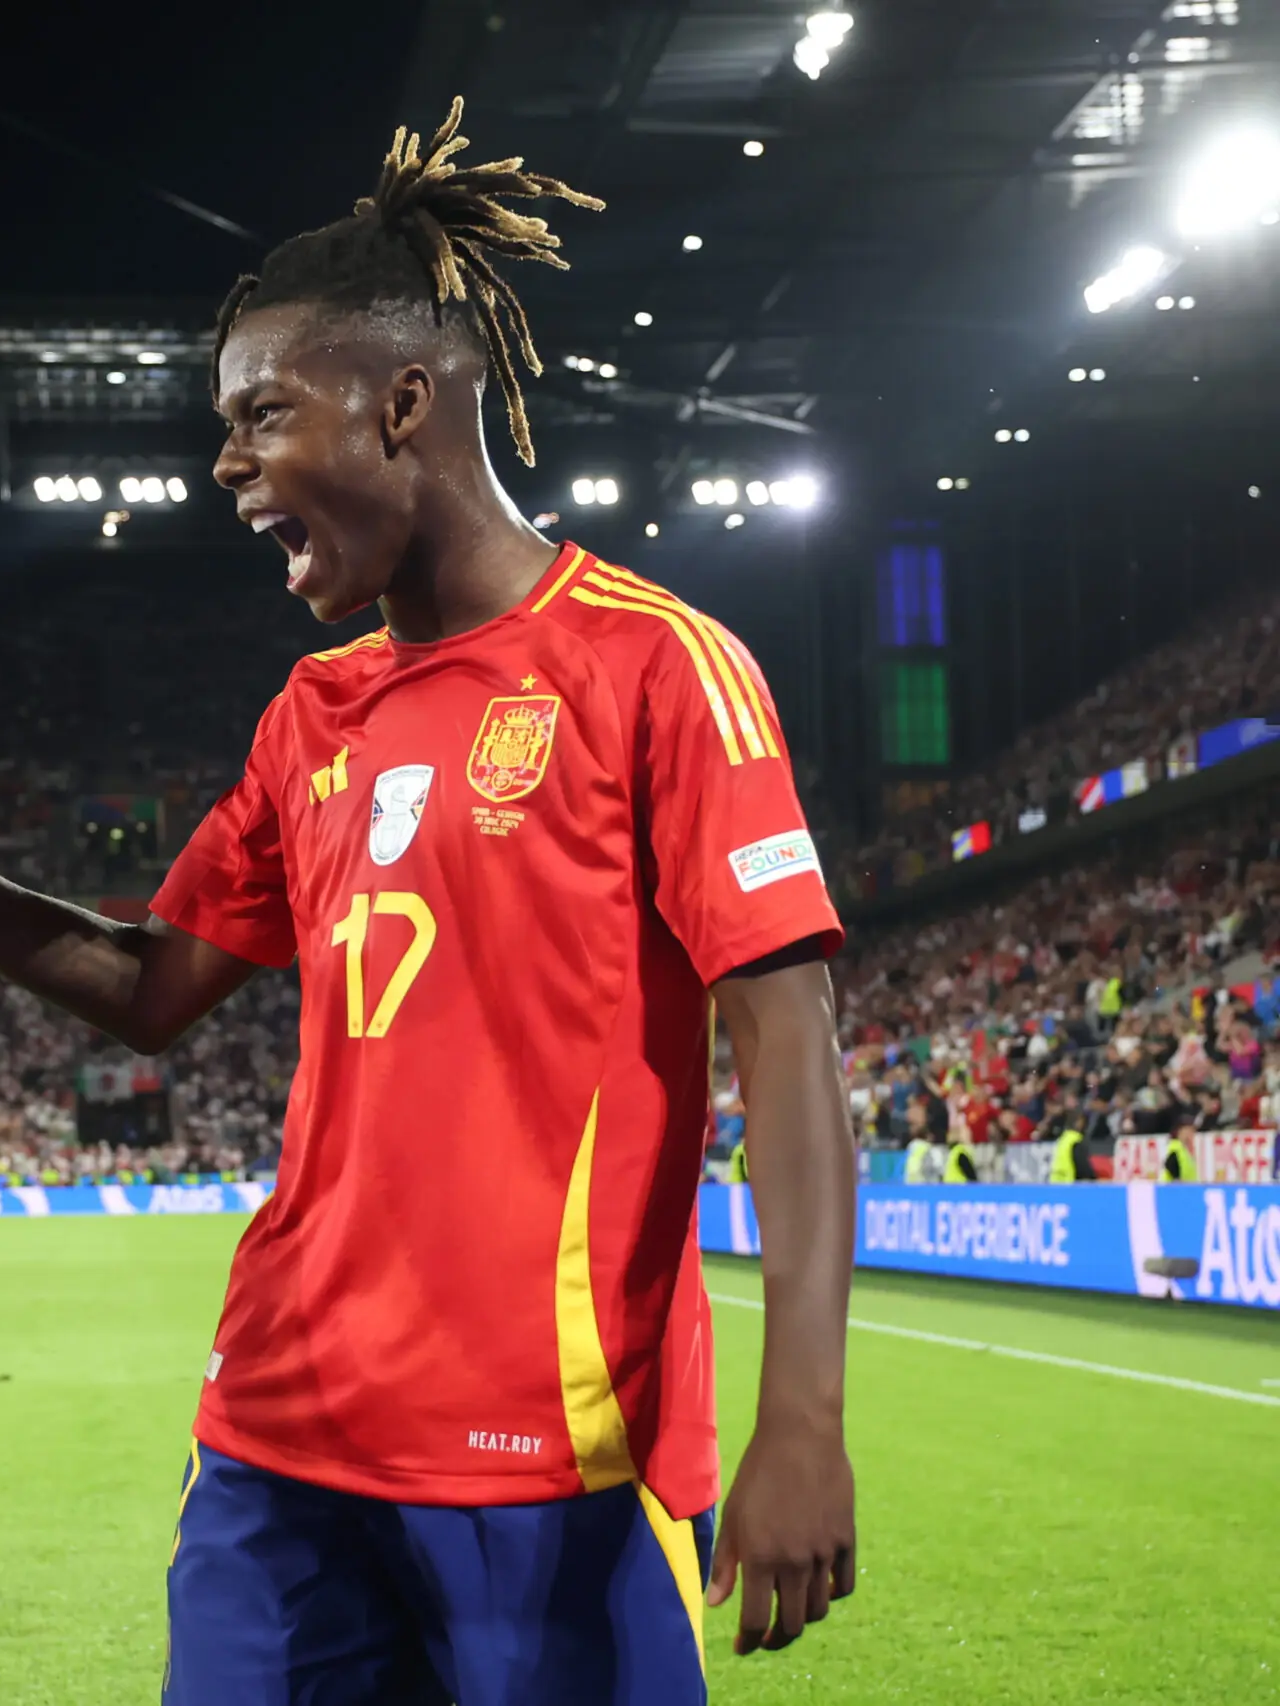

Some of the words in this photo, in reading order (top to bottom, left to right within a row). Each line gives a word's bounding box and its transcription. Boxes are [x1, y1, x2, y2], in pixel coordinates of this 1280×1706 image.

[331, 891, 437, 1038] 17
[865, 1199, 934, 1256] DIGITAL
[936, 1201, 1069, 1267] EXPERIENCE
[468, 1429, 542, 1455] HEAT.RDY
